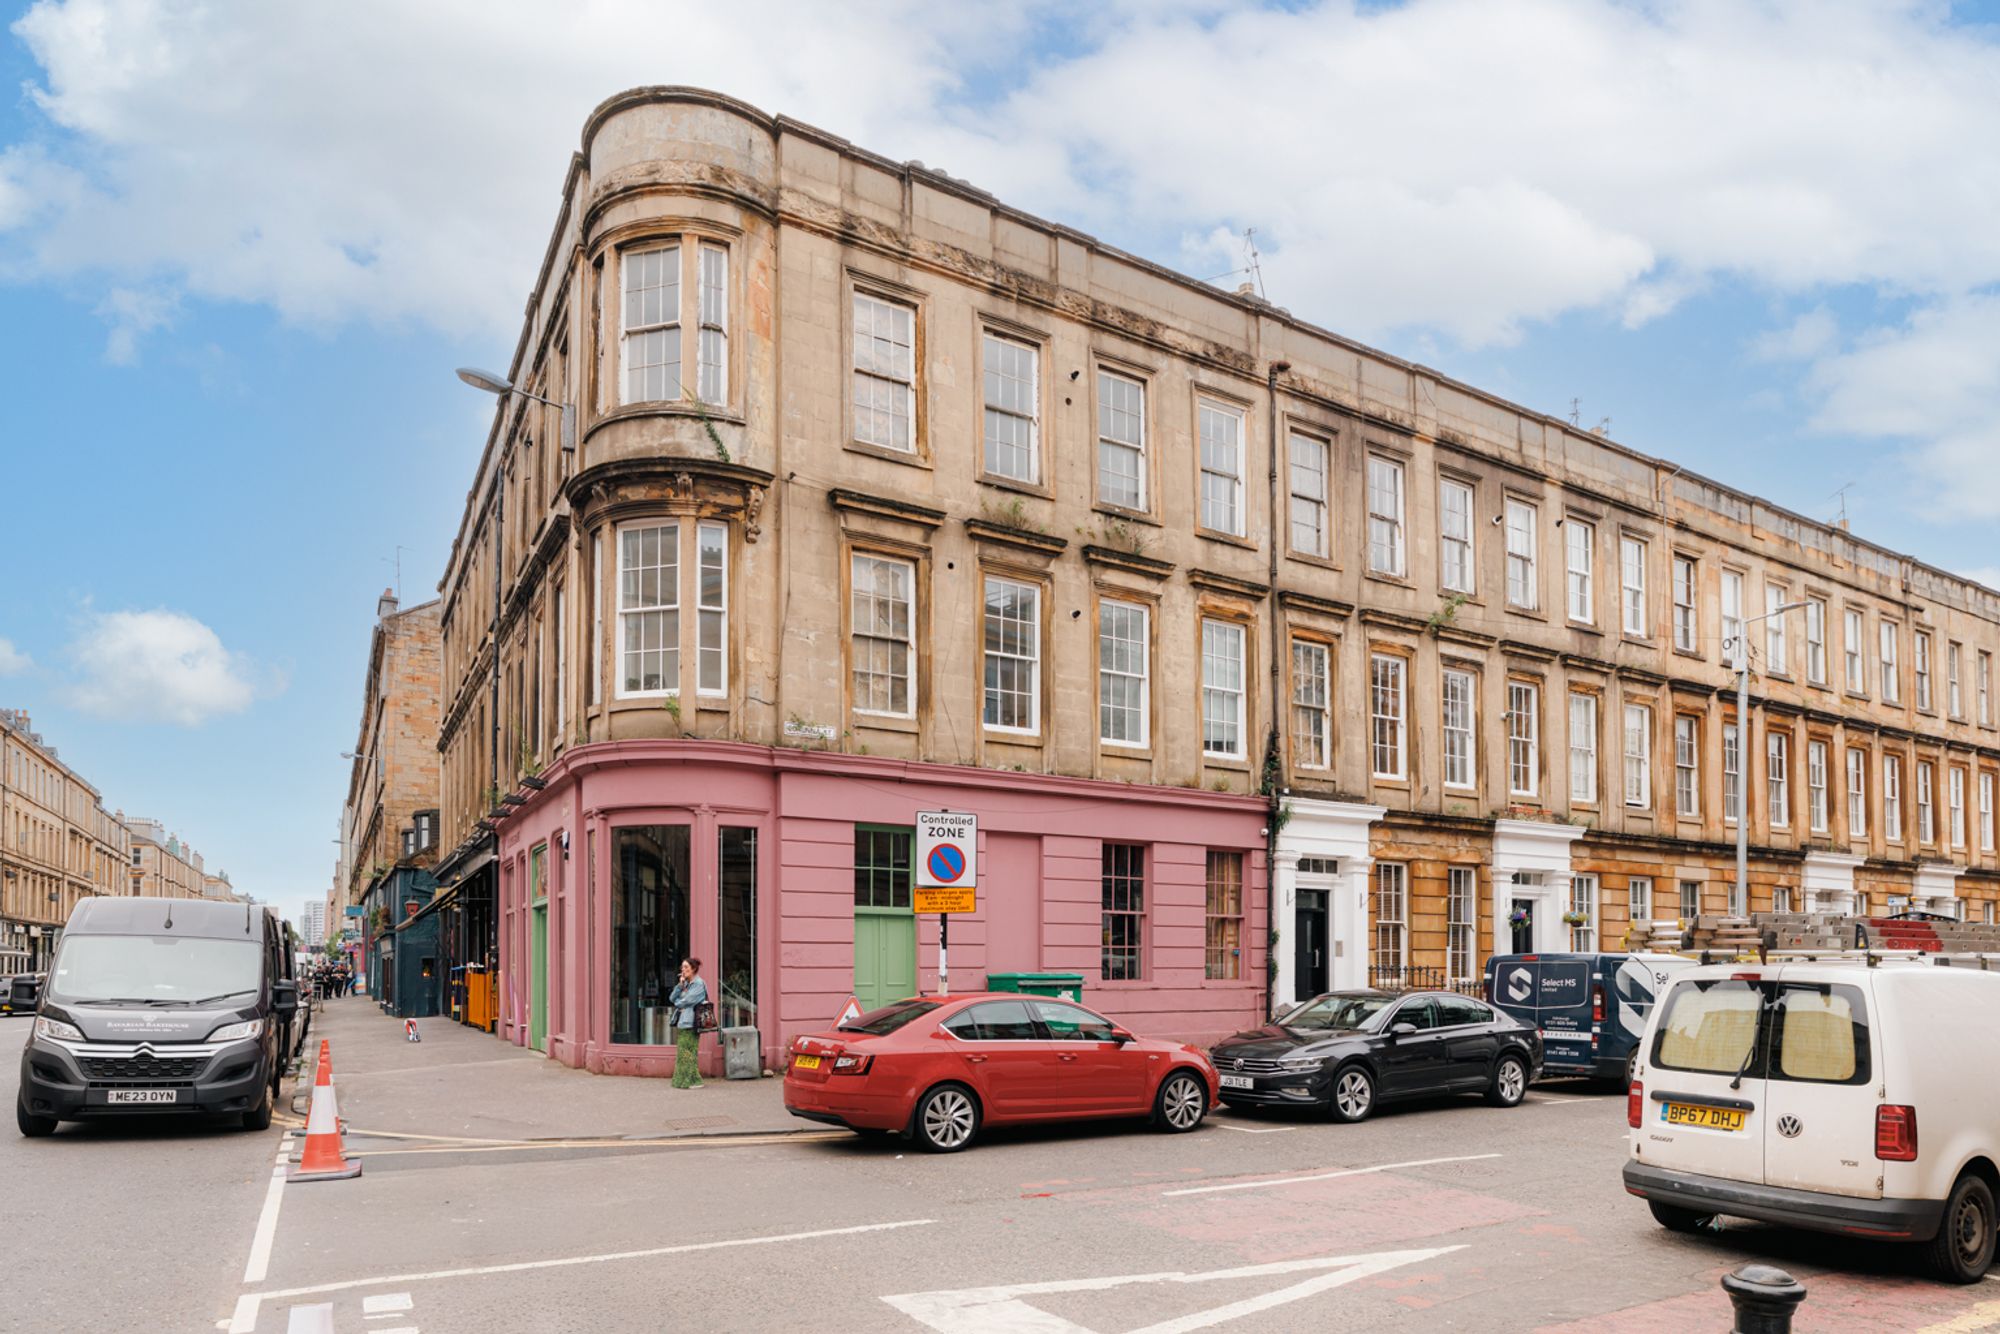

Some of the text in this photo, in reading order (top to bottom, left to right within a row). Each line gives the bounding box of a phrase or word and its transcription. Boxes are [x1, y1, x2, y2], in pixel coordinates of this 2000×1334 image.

[920, 814, 973, 826] Controlled
[928, 826, 965, 838] ZONE
[1541, 978, 1577, 987] Select MS
[116, 1091, 174, 1101] ME23 OYN
[1669, 1106, 1707, 1123] BP67
[1710, 1111, 1742, 1128] DHJ
